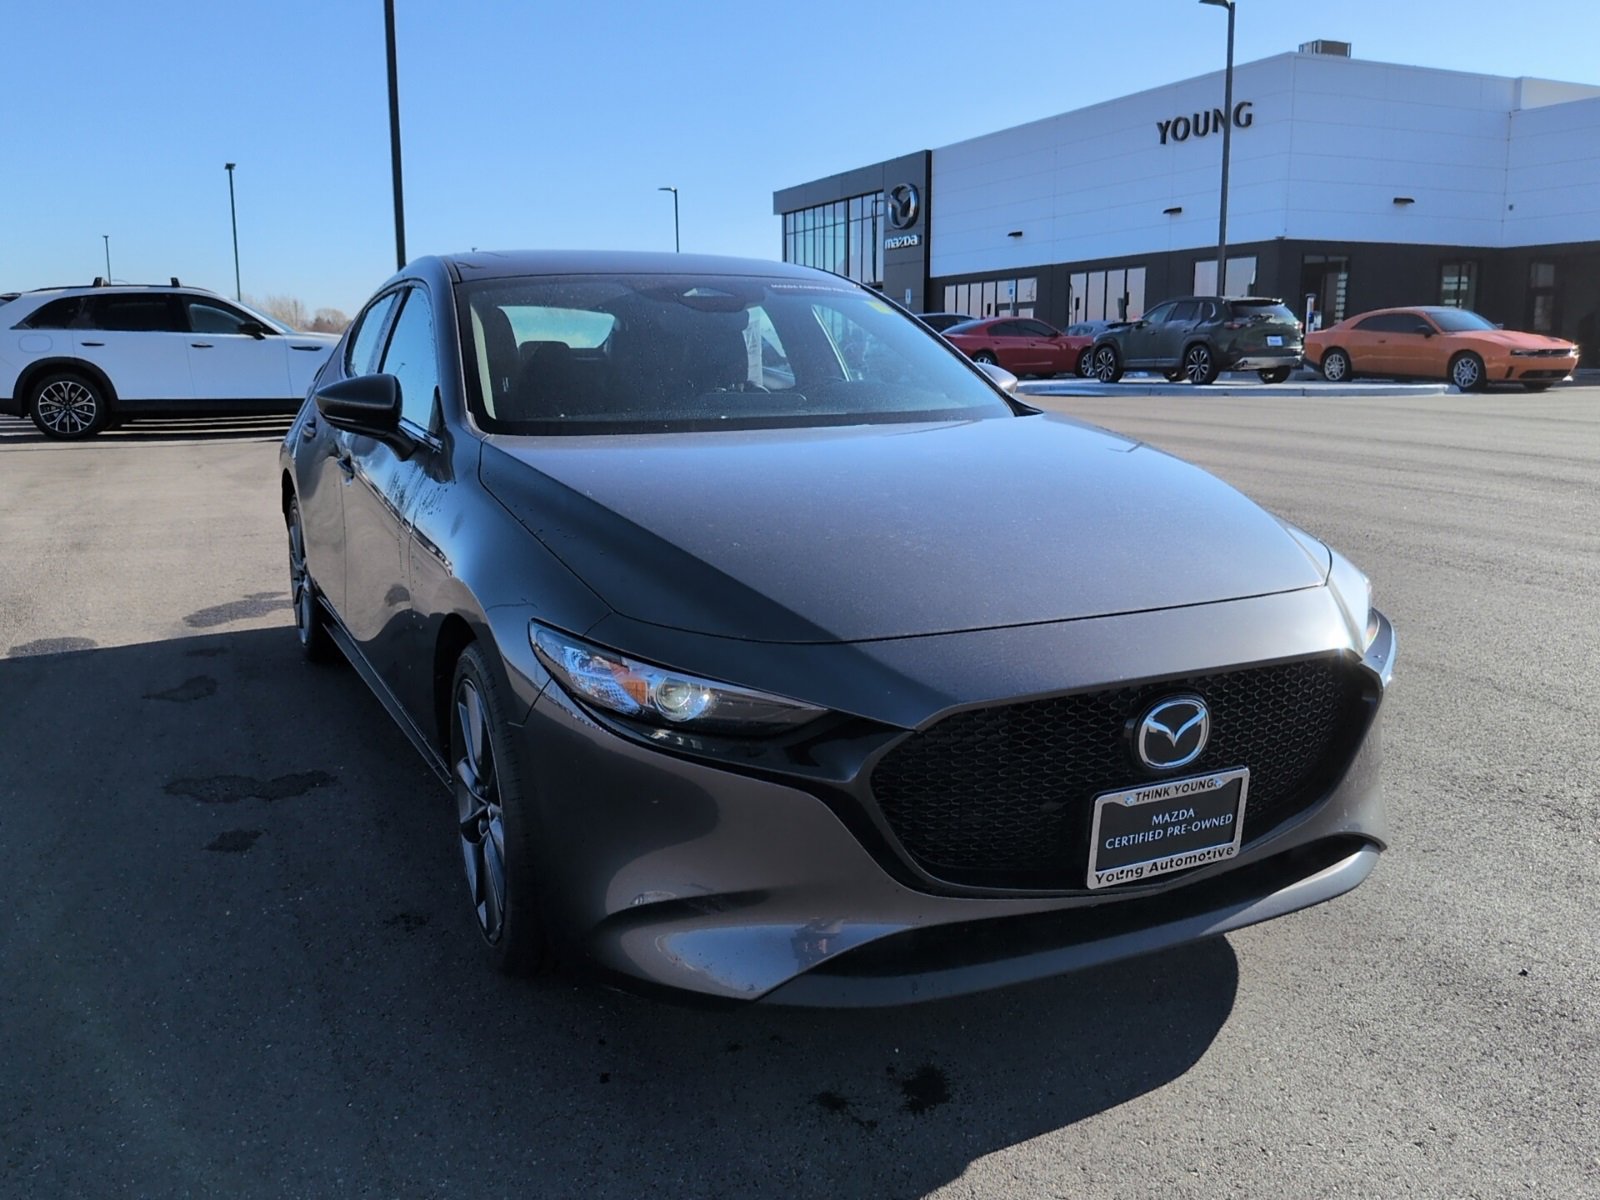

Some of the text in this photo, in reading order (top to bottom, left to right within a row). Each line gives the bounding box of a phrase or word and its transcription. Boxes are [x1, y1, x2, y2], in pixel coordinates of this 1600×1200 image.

[1156, 101, 1253, 145] YOUNG
[884, 234, 918, 250] mazda
[1136, 788, 1170, 802] THINK
[1151, 807, 1195, 826] MAZDA
[1105, 813, 1233, 849] CERTIFIED PRE-OWNED
